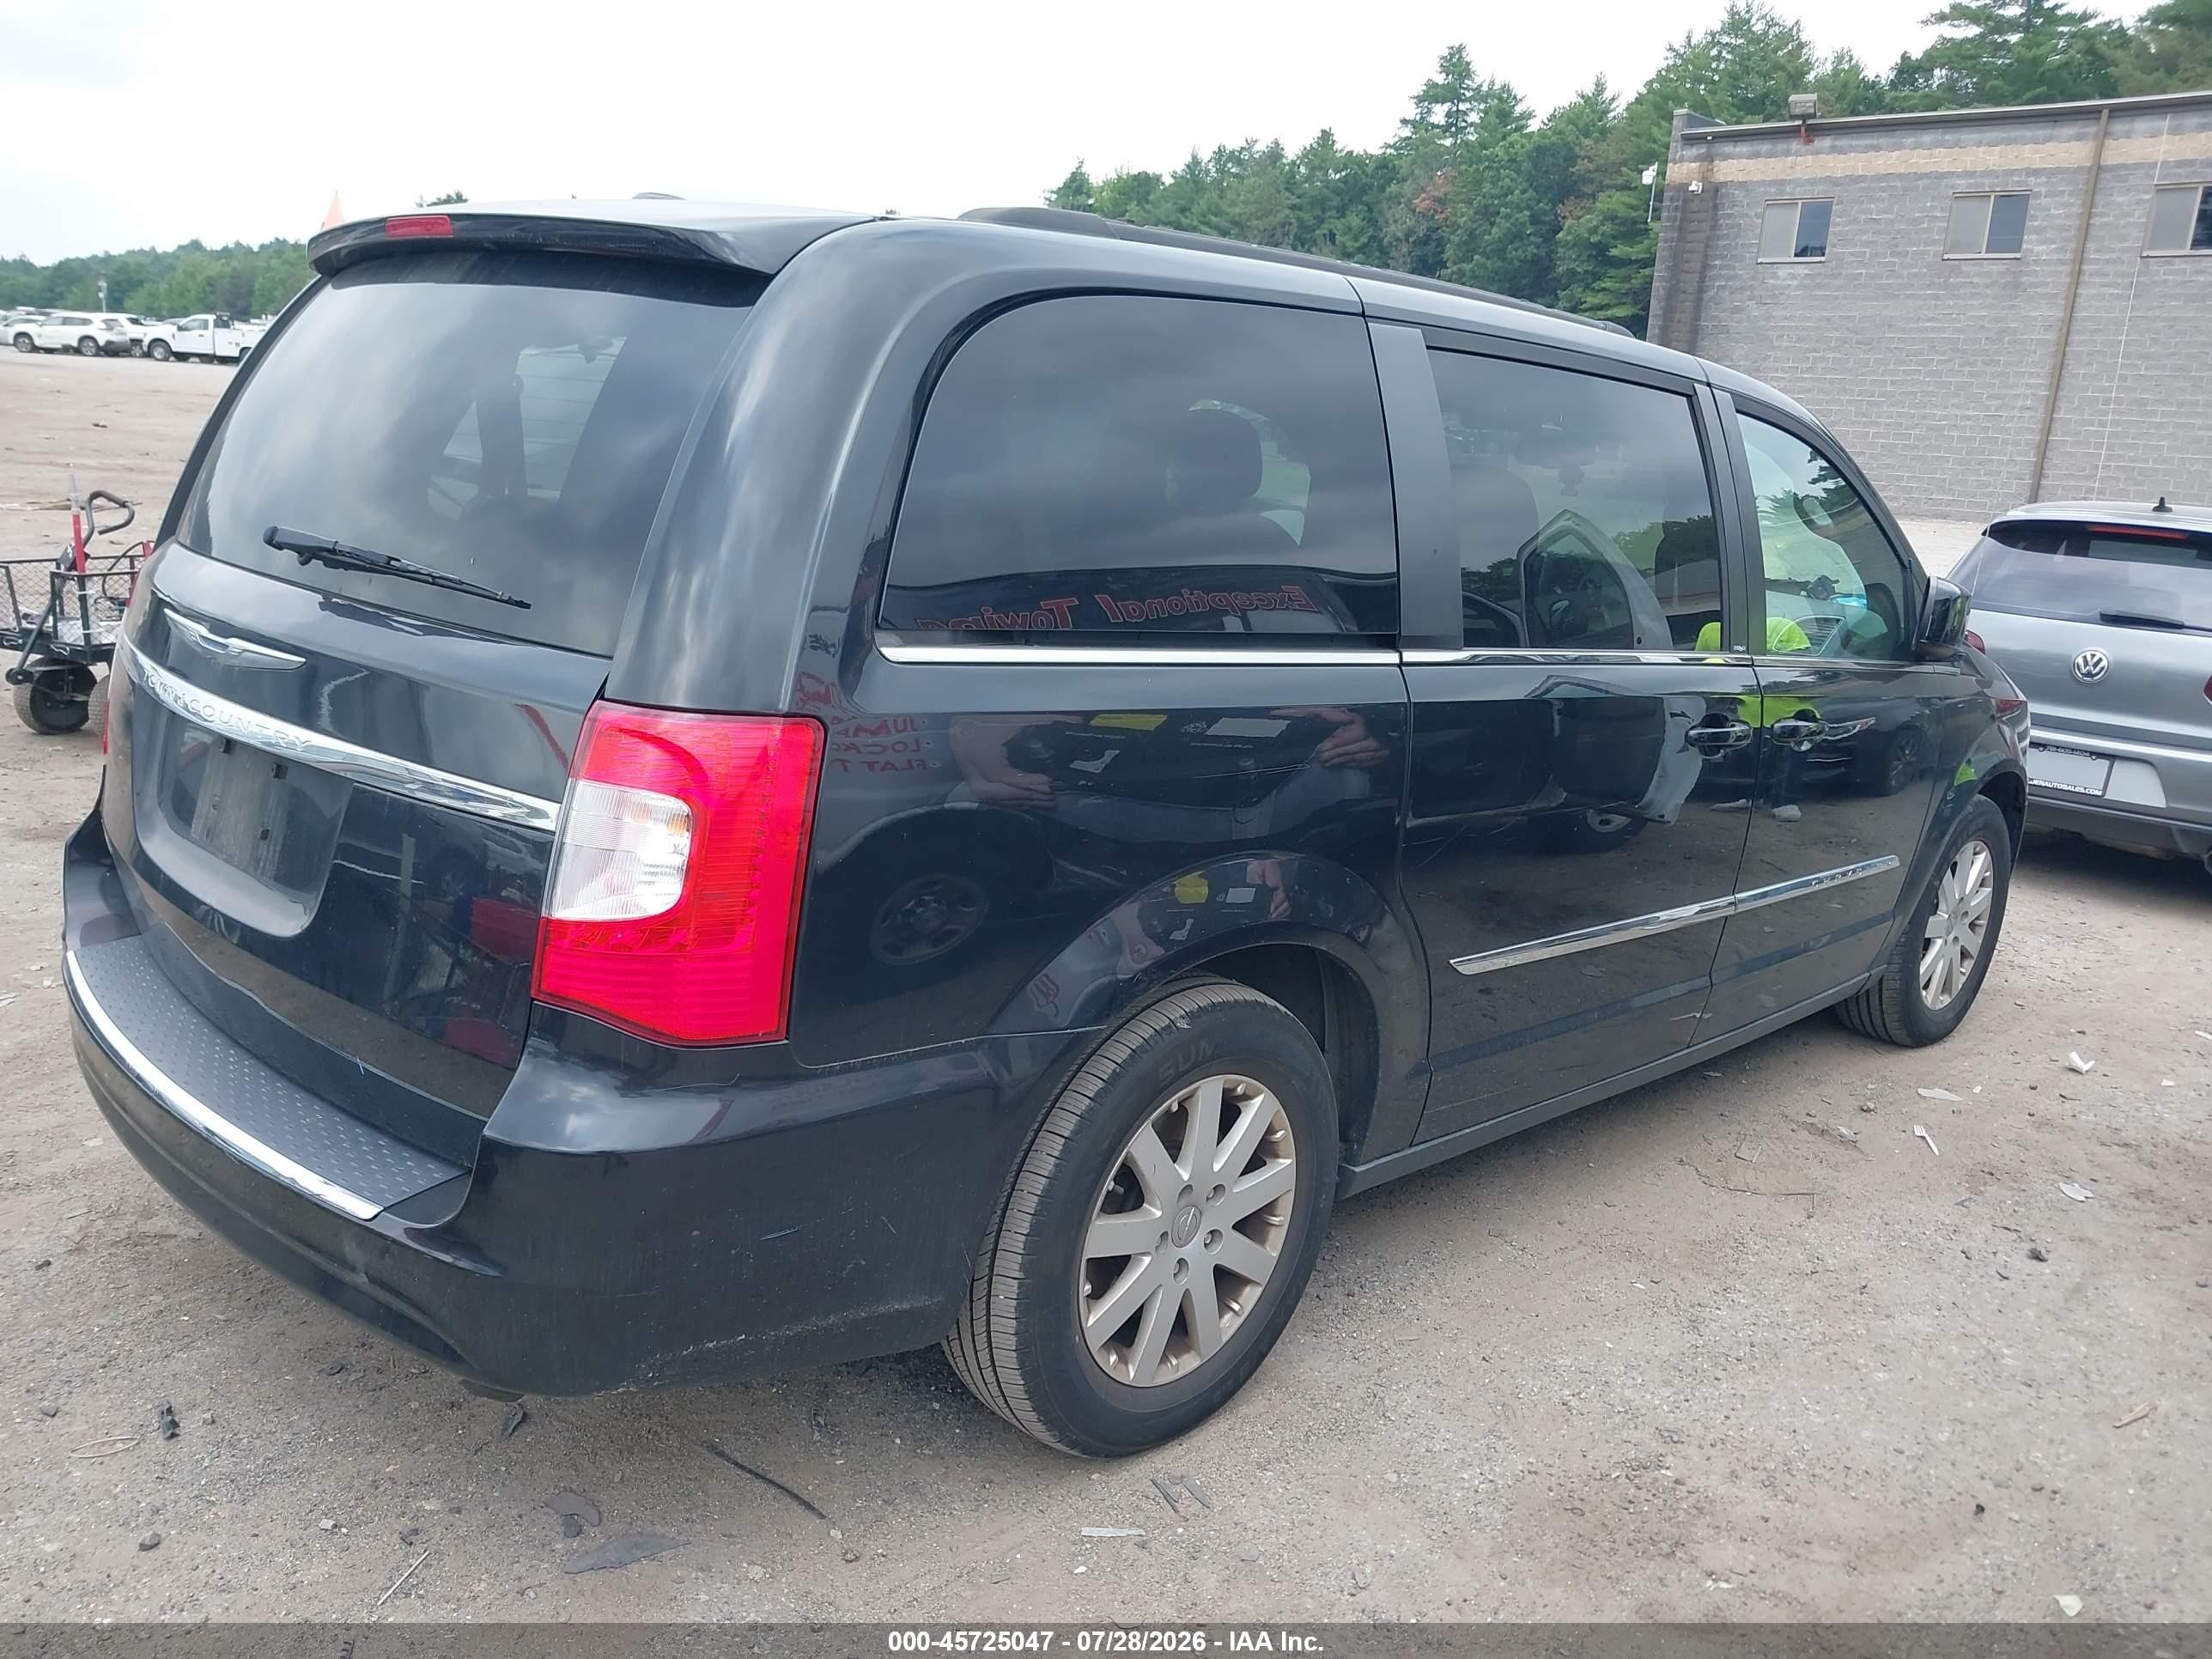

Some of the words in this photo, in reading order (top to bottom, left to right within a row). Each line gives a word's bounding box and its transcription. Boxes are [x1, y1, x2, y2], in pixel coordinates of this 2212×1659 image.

[2074, 650, 2108, 682] VW
[143, 670, 177, 699] TOWN
[189, 698, 312, 751] COUNTRY
